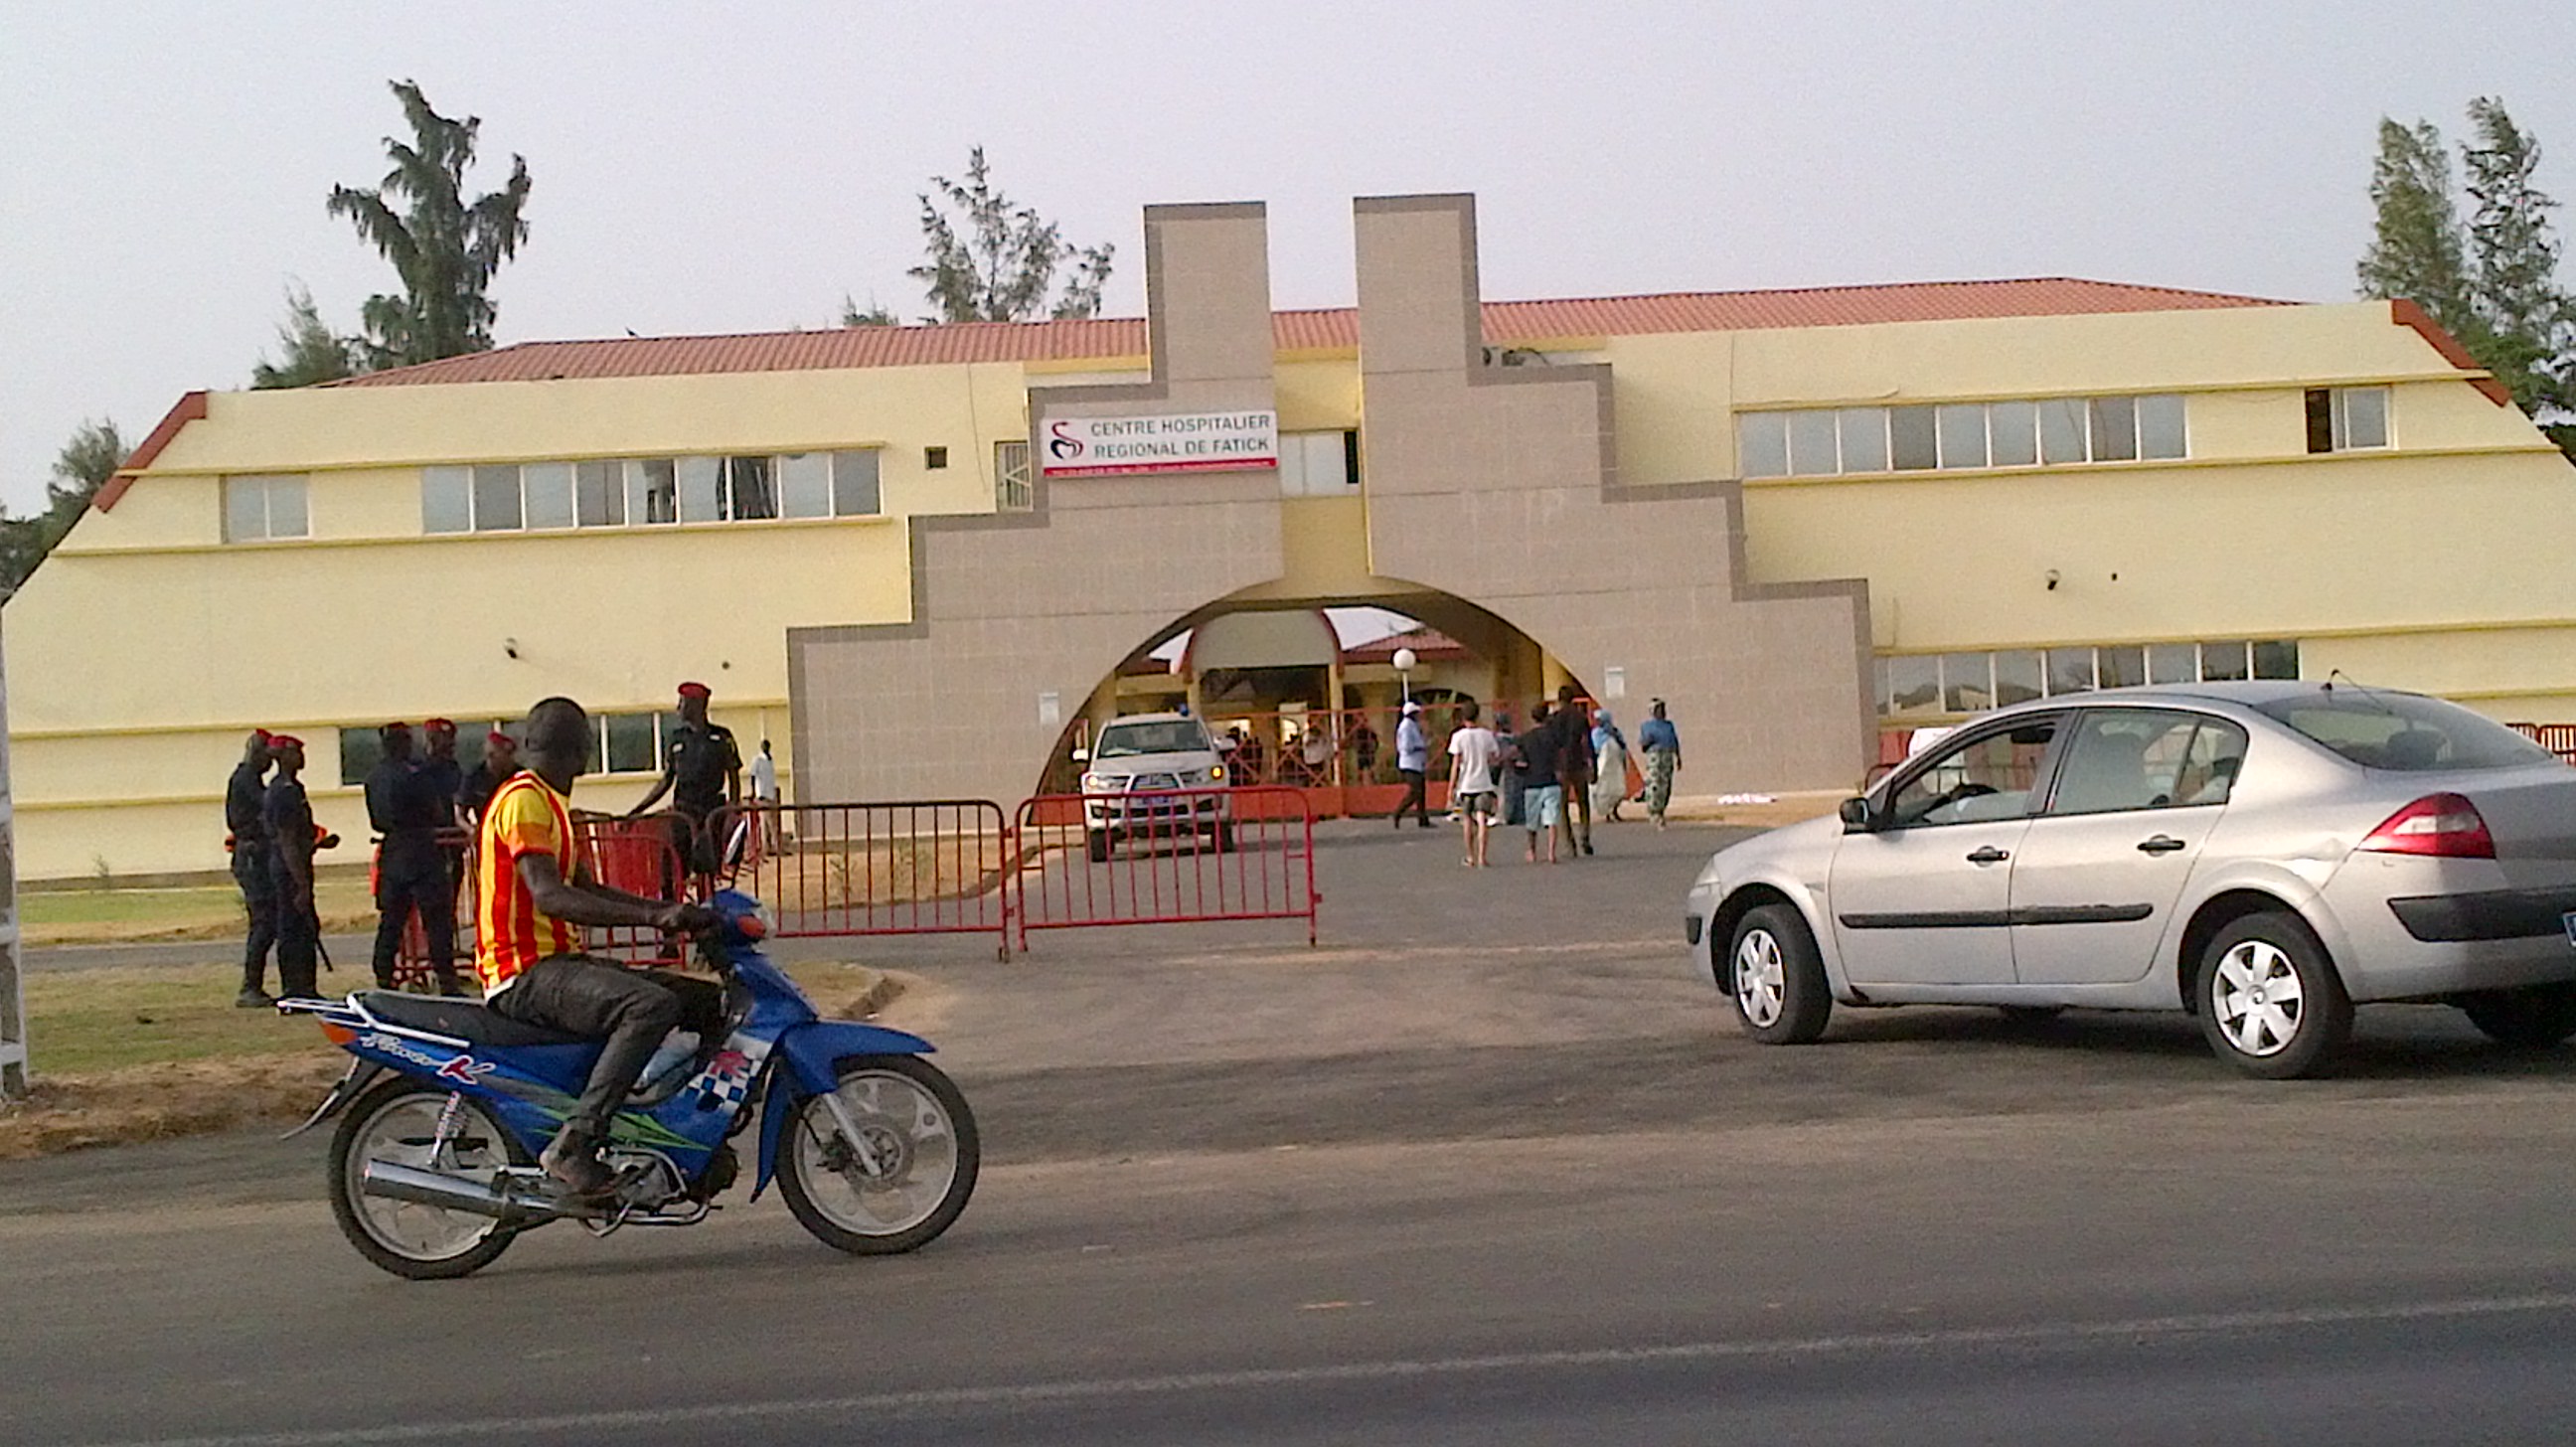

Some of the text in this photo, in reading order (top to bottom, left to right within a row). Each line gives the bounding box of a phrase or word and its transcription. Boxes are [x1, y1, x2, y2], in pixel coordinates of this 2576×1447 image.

[1090, 414, 1270, 437] CENTRE HOSPITALIER
[1094, 437, 1269, 459] REGIONAL DE FATICK
